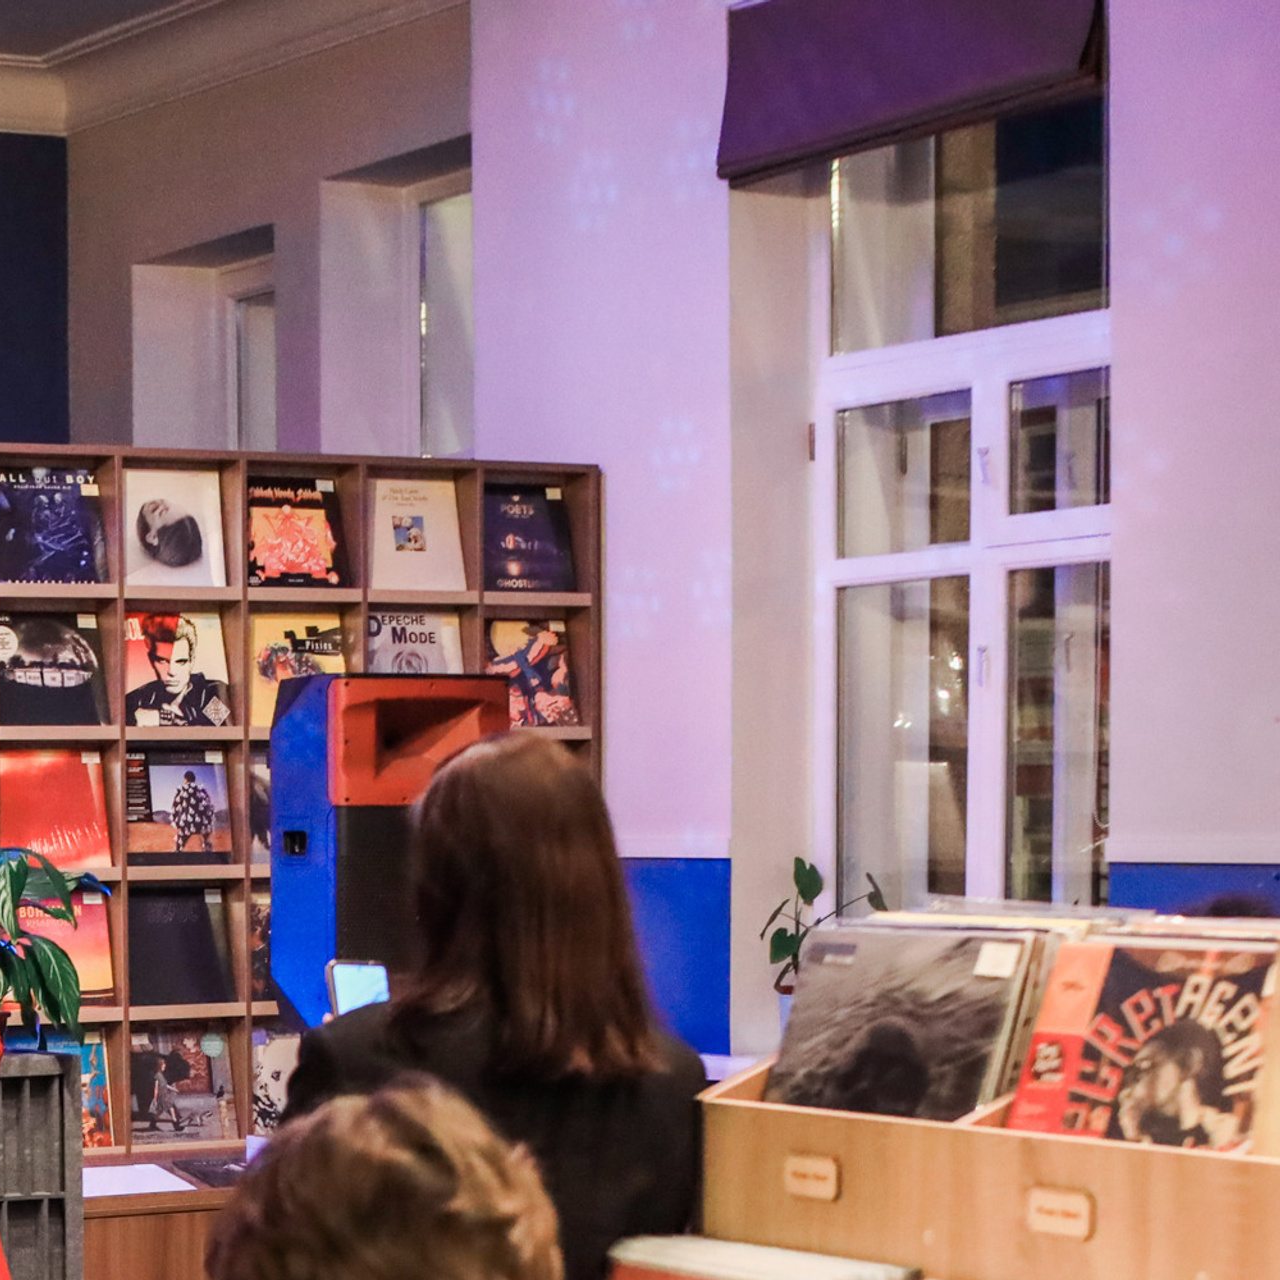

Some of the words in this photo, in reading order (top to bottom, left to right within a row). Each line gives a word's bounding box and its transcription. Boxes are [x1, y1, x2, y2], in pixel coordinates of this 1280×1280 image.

[65, 474, 95, 484] BOY
[368, 614, 426, 637] DEPECHE
[391, 626, 436, 644] MODE
